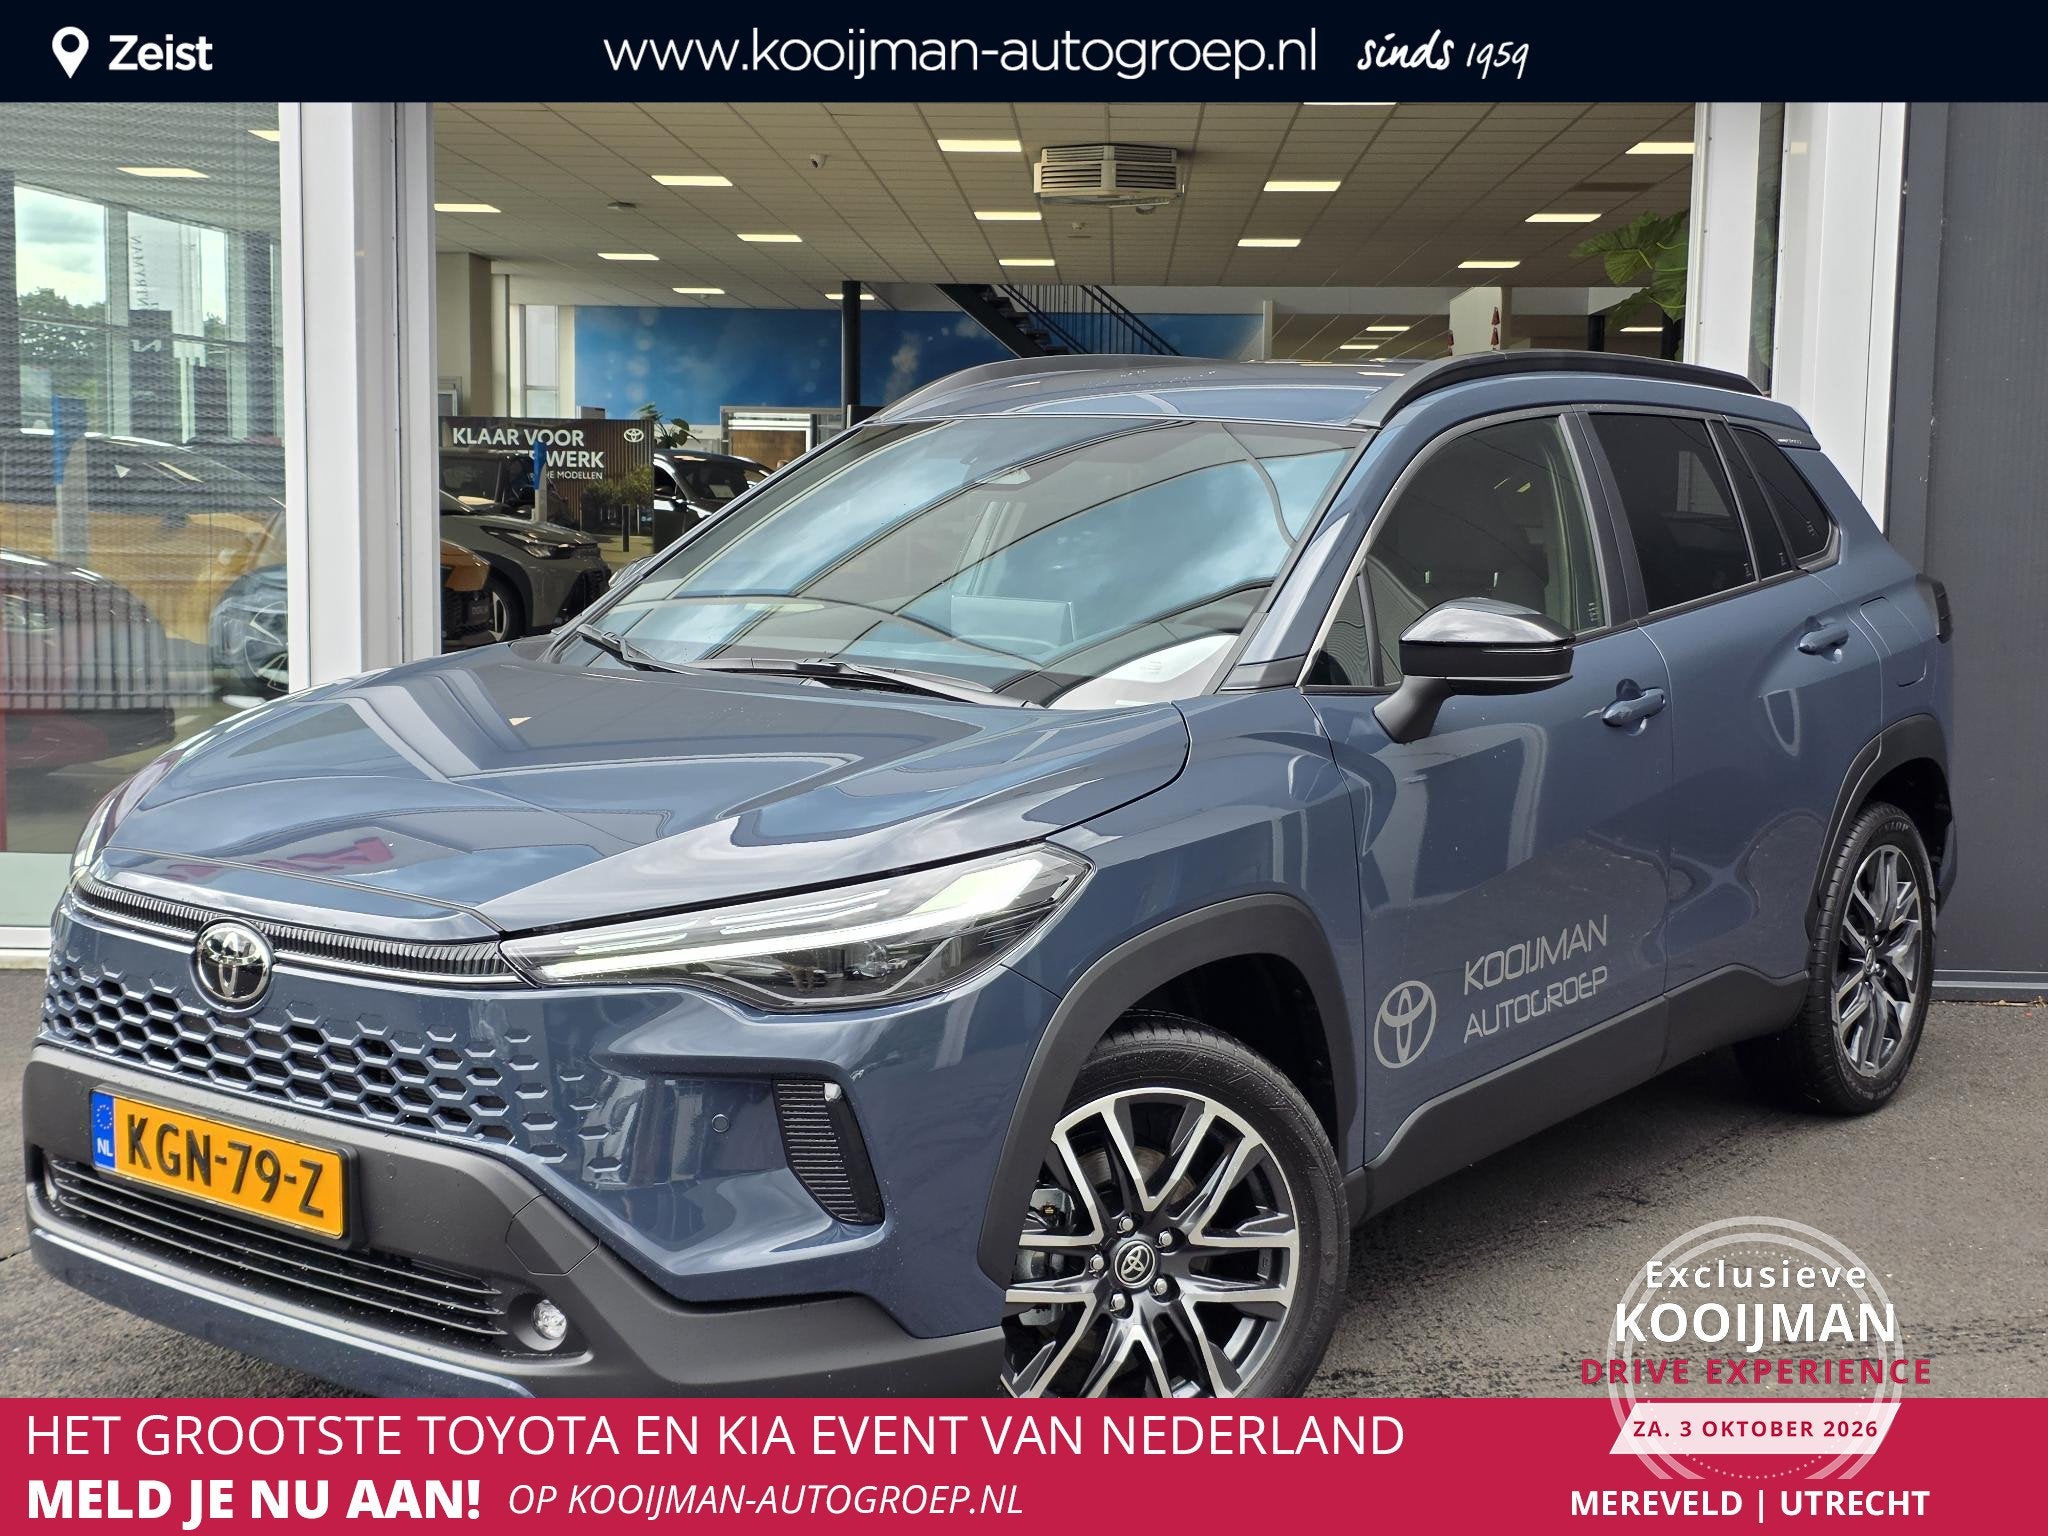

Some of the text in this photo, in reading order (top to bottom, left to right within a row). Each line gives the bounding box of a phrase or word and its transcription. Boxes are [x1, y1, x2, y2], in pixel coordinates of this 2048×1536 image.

[453, 428, 584, 447] KLAAR VOOR
[546, 450, 605, 468] WERK
[557, 470, 603, 480] MODELLEN
[1463, 914, 1608, 996] KOOIJMAN
[1463, 965, 1608, 1044] AUTOGROEP
[96, 1137, 113, 1157] NL
[127, 1113, 324, 1218] KGN-79-Z
